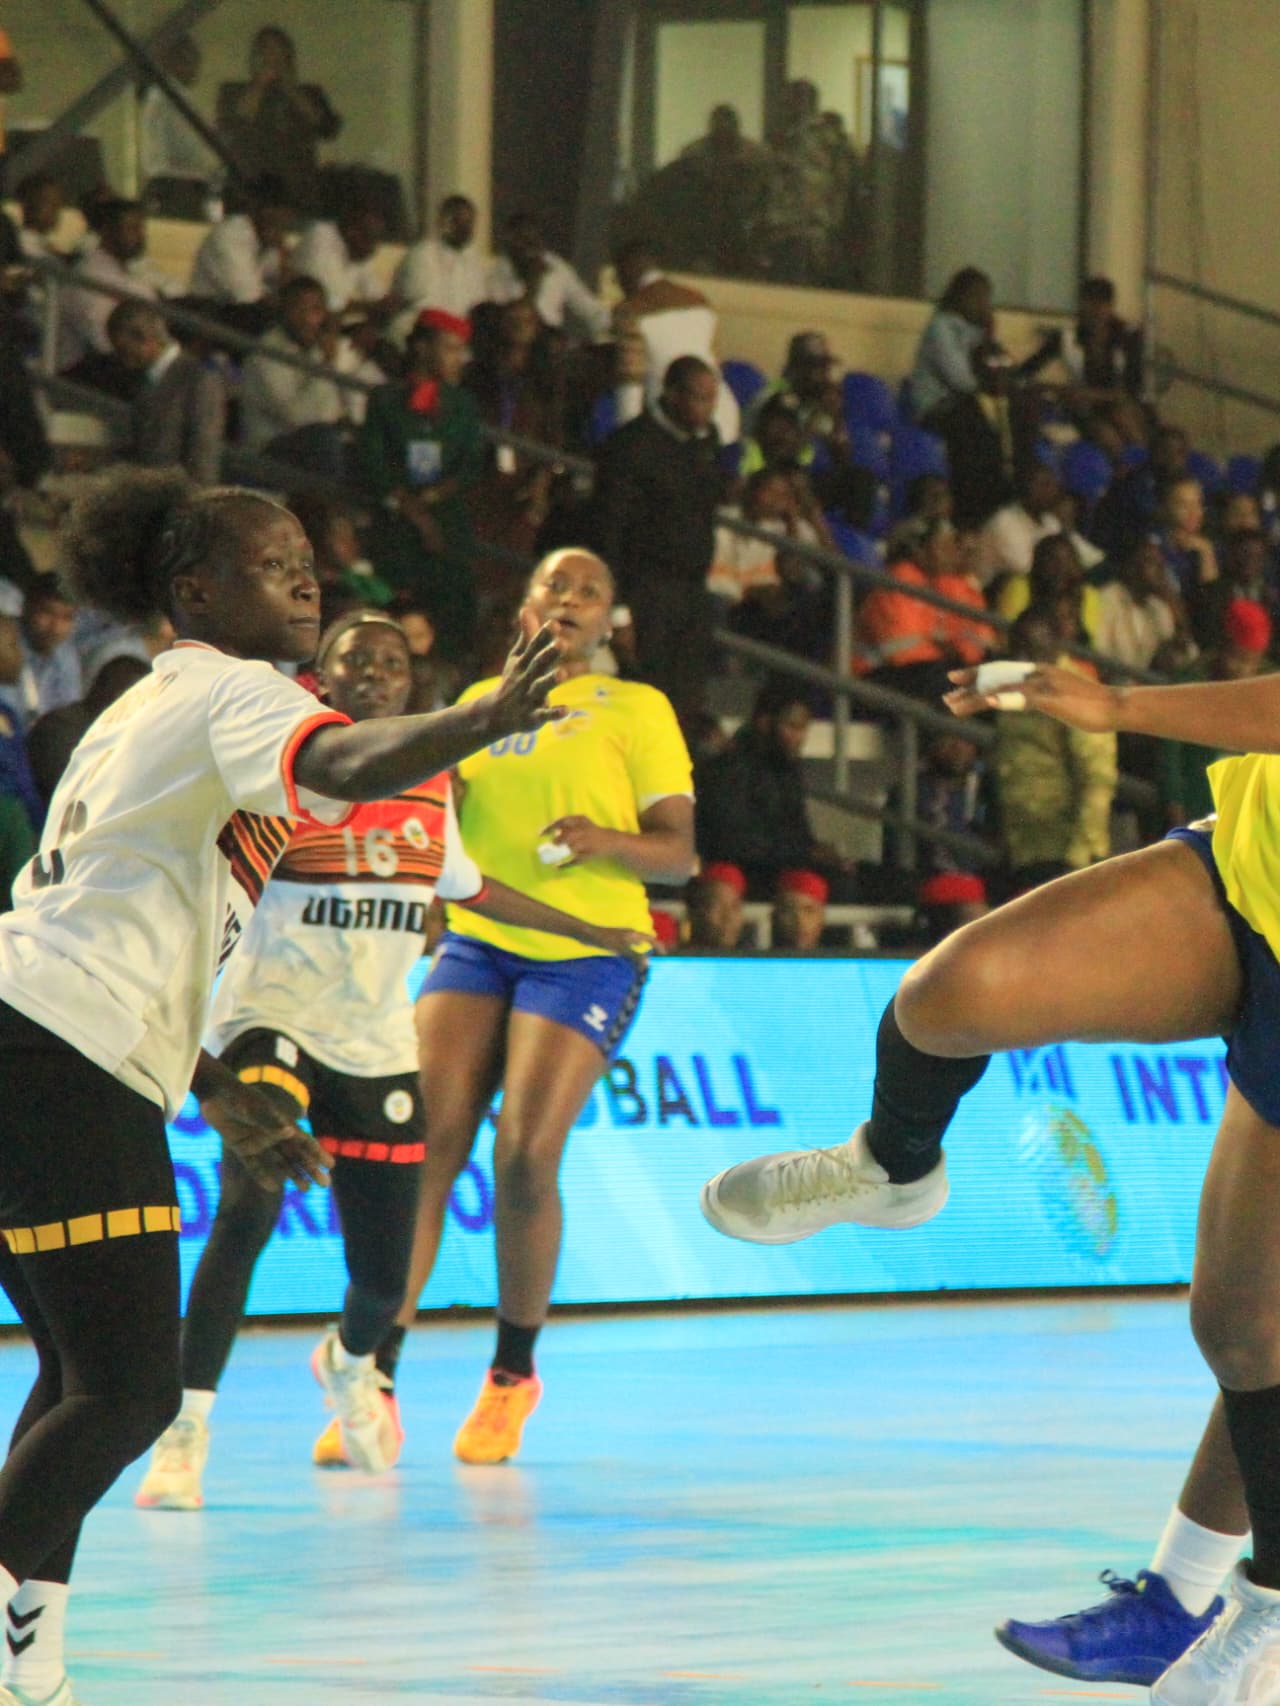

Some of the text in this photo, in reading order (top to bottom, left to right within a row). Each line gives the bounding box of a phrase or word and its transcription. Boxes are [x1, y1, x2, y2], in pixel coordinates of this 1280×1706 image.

[341, 826, 399, 877] 16
[302, 897, 426, 933] UGAND
[580, 1054, 780, 1126] BALL
